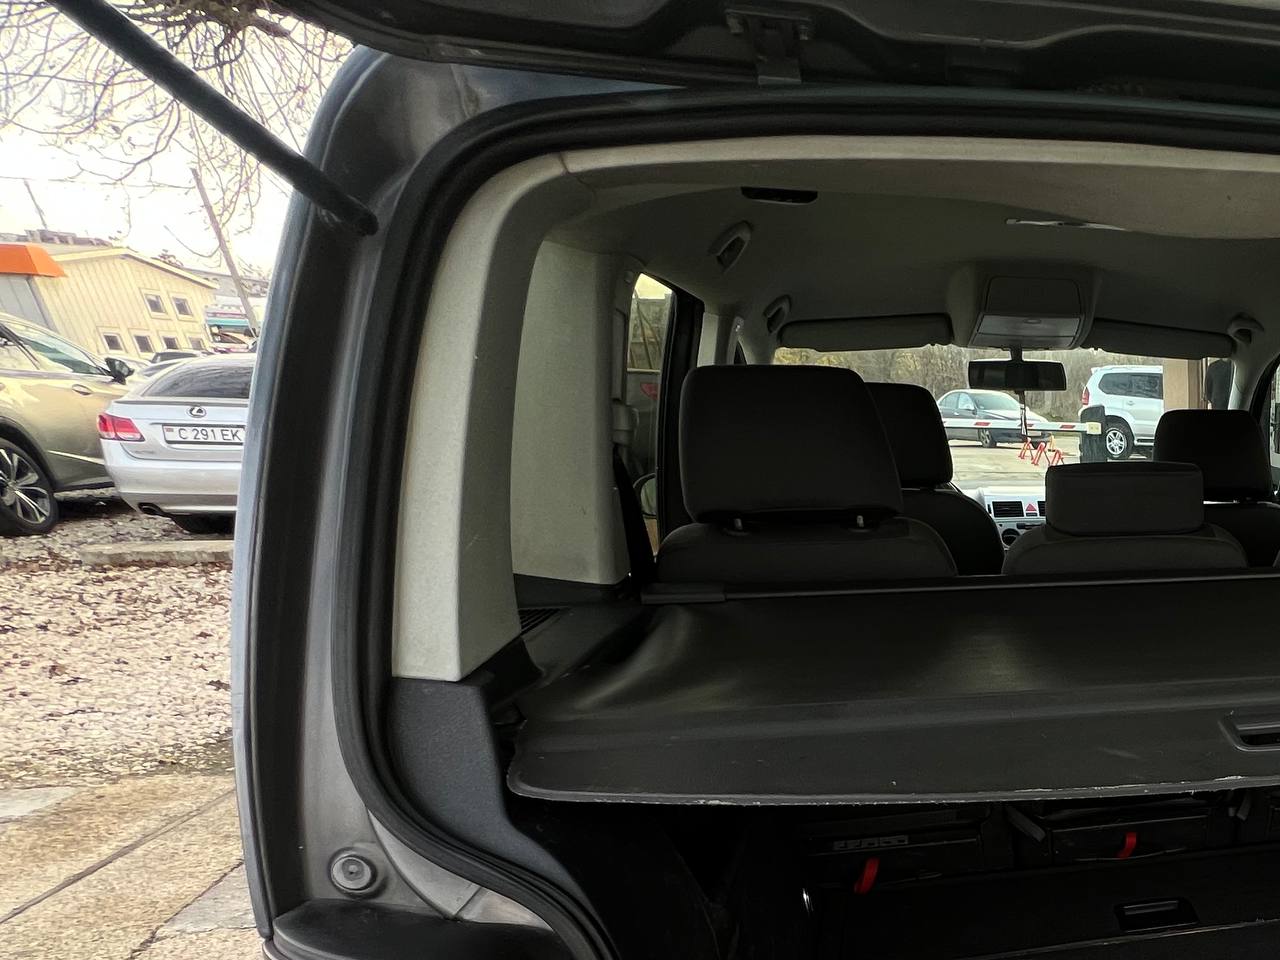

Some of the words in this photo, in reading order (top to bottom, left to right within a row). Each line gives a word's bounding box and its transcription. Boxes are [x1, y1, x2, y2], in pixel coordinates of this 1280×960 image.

[178, 428, 188, 440] C
[193, 428, 217, 441] 291
[221, 428, 242, 442] EK
